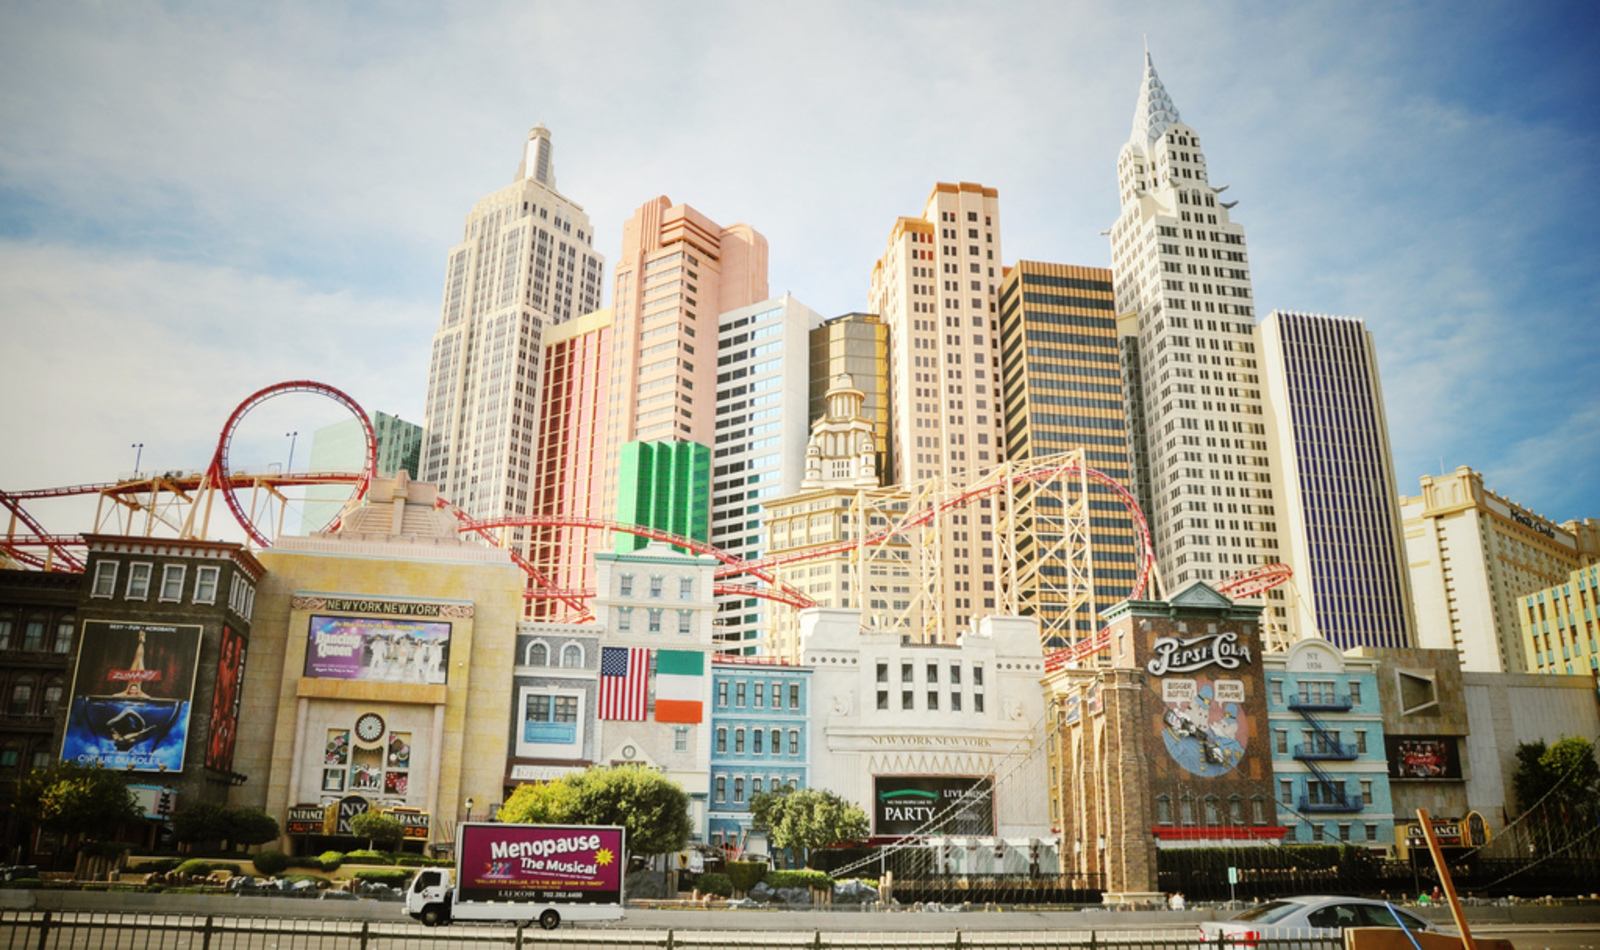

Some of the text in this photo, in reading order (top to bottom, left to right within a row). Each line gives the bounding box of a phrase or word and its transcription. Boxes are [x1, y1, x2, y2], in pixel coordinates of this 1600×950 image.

[327, 600, 440, 616] NEW YORK NEW YORK
[871, 736, 991, 747] NEW YORK NEW YORK
[288, 810, 323, 820] ENTRANCE
[341, 803, 367, 815] NY
[884, 807, 935, 821] PARTY
[1409, 826, 1457, 836] ENANCE
[491, 834, 600, 859] Menopause
[520, 857, 597, 874] The Musical
